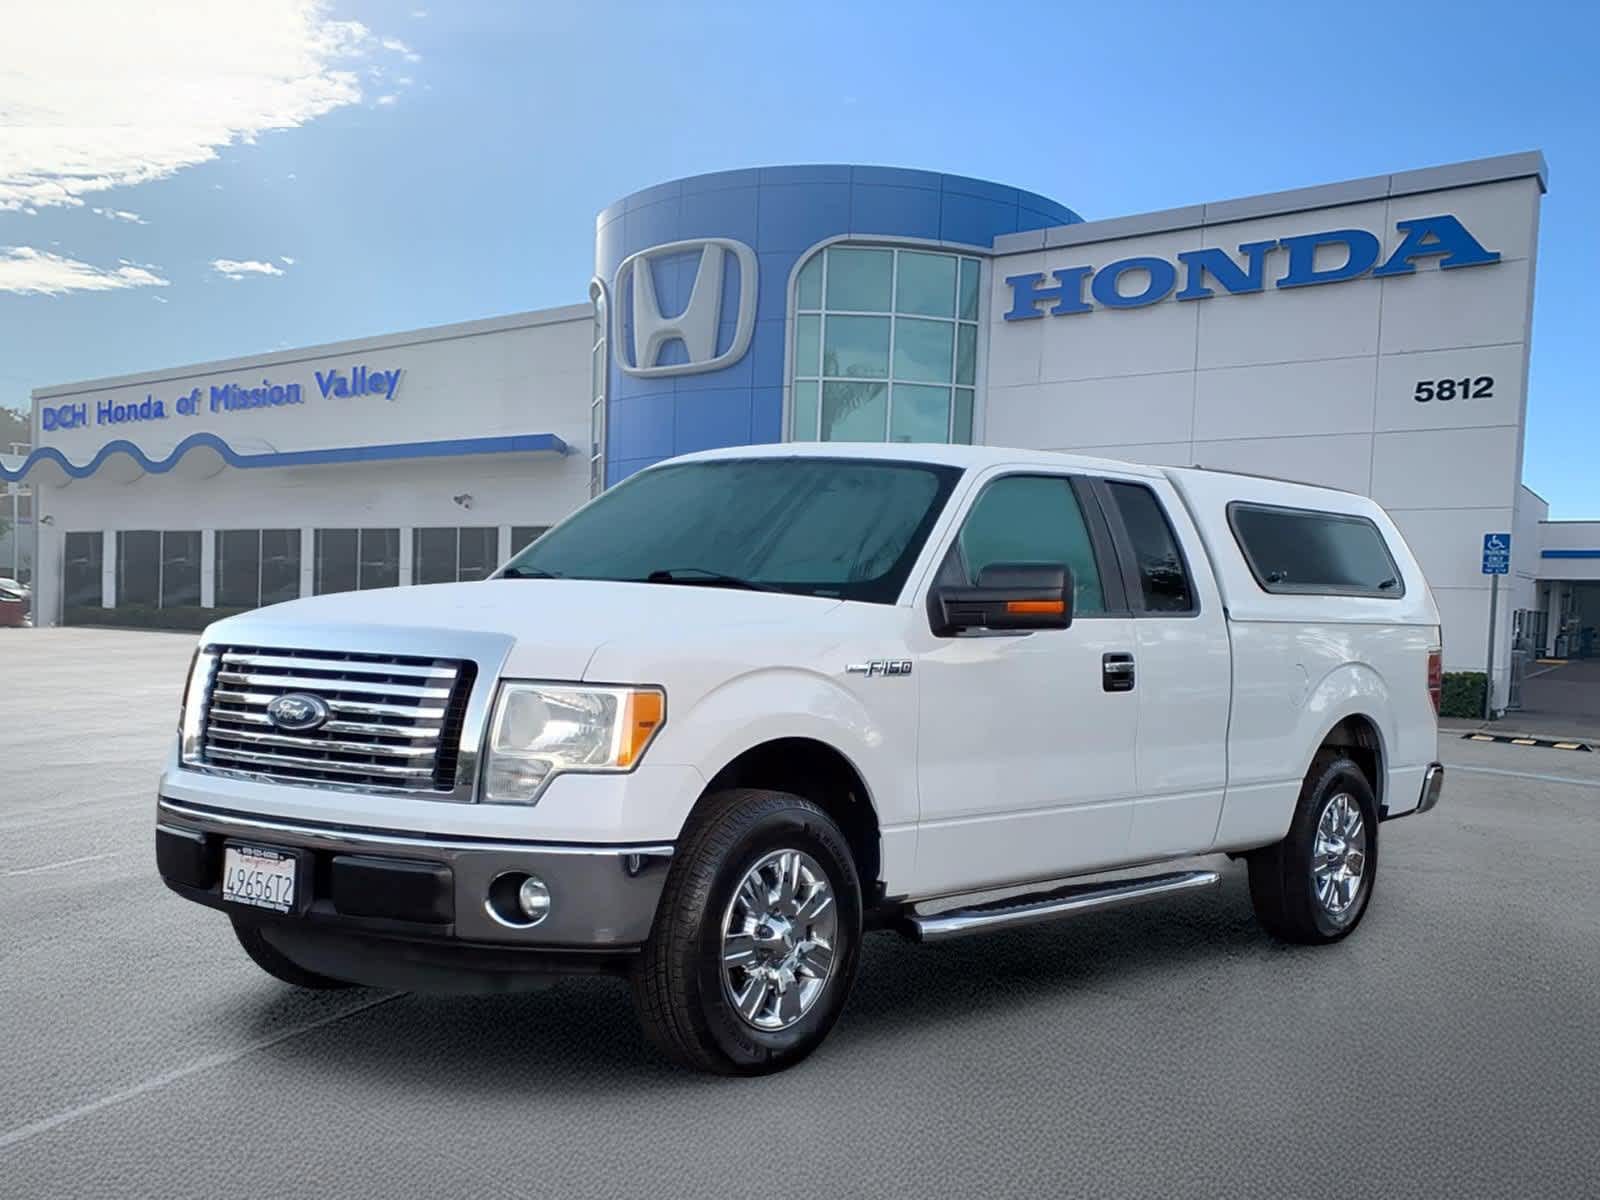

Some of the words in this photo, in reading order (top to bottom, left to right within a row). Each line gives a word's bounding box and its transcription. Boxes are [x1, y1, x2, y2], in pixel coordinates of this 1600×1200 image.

[1003, 213, 1502, 322] HONDA
[42, 405, 87, 431] DCH
[96, 394, 165, 425] Honda
[175, 387, 203, 416] of
[210, 379, 304, 413] Mission
[315, 366, 402, 400] Valley
[1414, 375, 1495, 402] 5812
[226, 866, 292, 904] 49656T2
